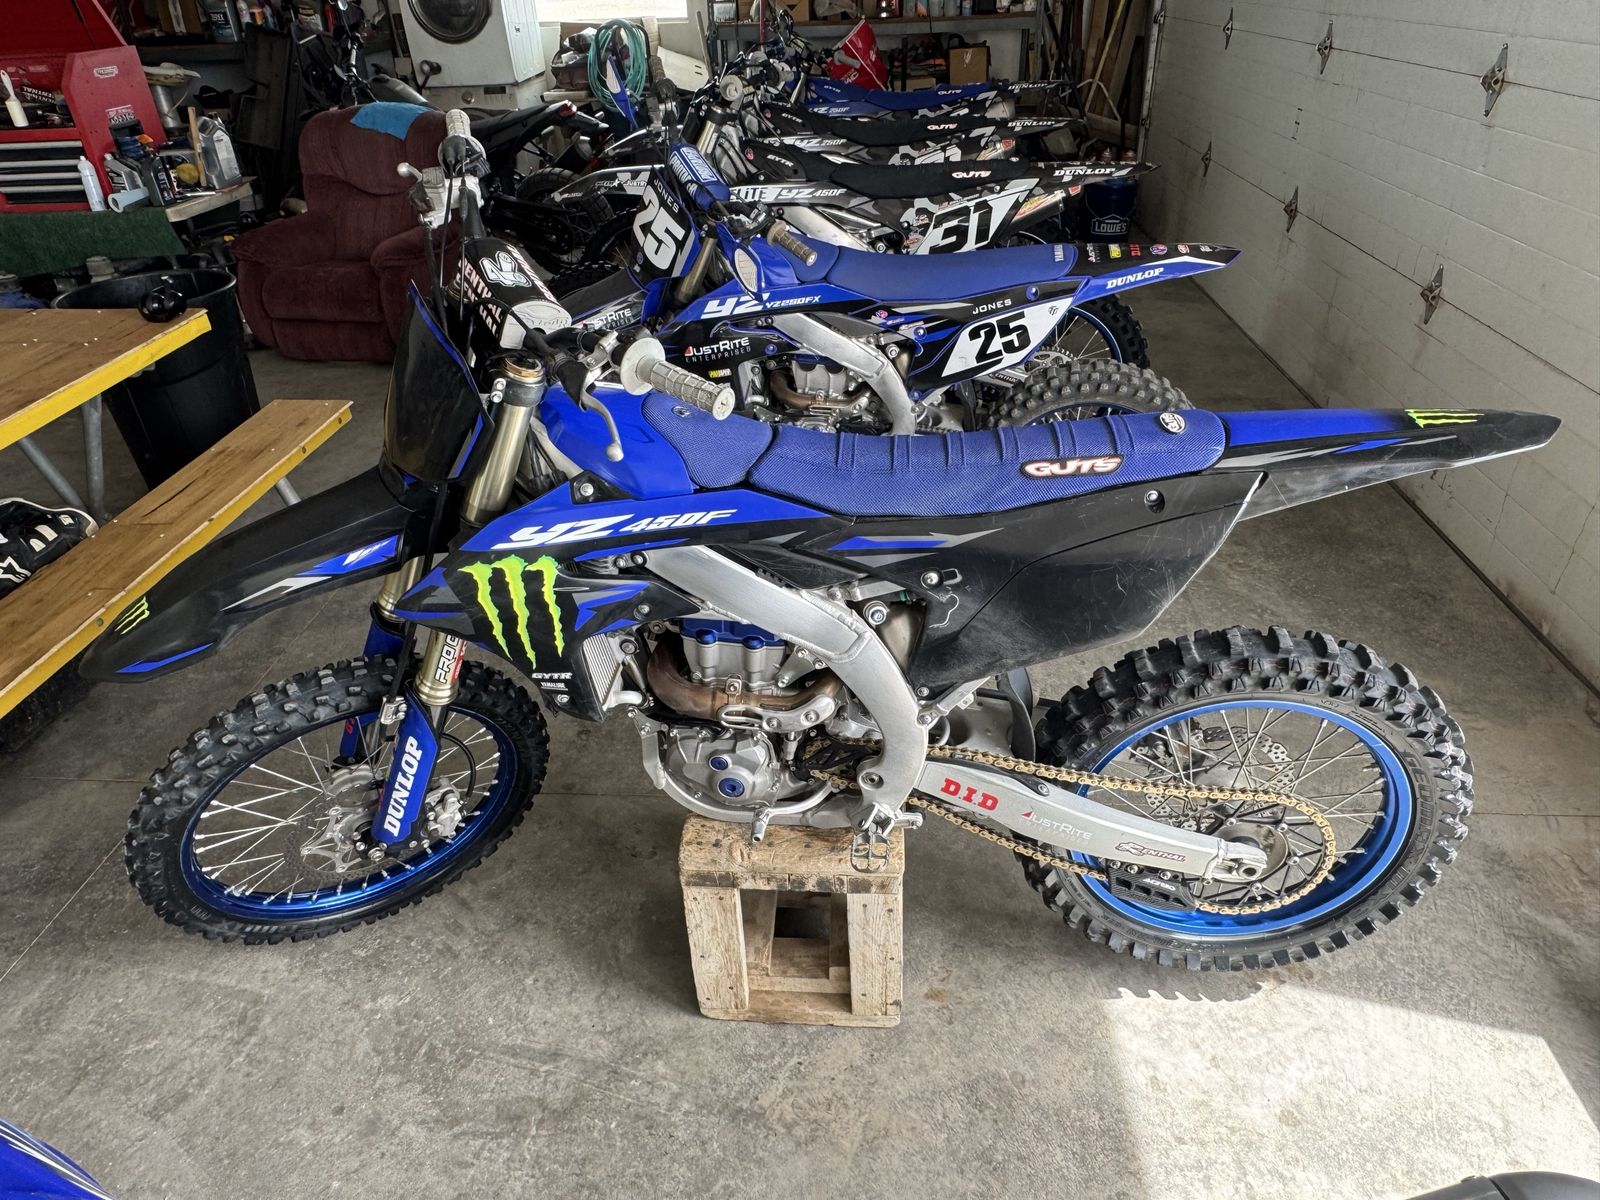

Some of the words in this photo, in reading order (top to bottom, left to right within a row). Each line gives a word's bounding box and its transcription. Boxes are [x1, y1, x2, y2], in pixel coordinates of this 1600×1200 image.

[1053, 168, 1117, 176] DUNLOP
[653, 178, 679, 214] JONES
[812, 188, 848, 197] 450F
[633, 185, 686, 270] 25
[1095, 222, 1127, 232] LOWE'S
[1105, 267, 1164, 289] DUNLOP
[972, 299, 1012, 315] JONES
[967, 311, 1032, 364] 25
[1024, 456, 1121, 477] GUTS
[491, 514, 635, 550] YZ
[619, 509, 738, 532] 450F
[531, 672, 573, 680] GYTR
[384, 735, 423, 837] DUNLOP
[940, 778, 999, 811] D.I.D
